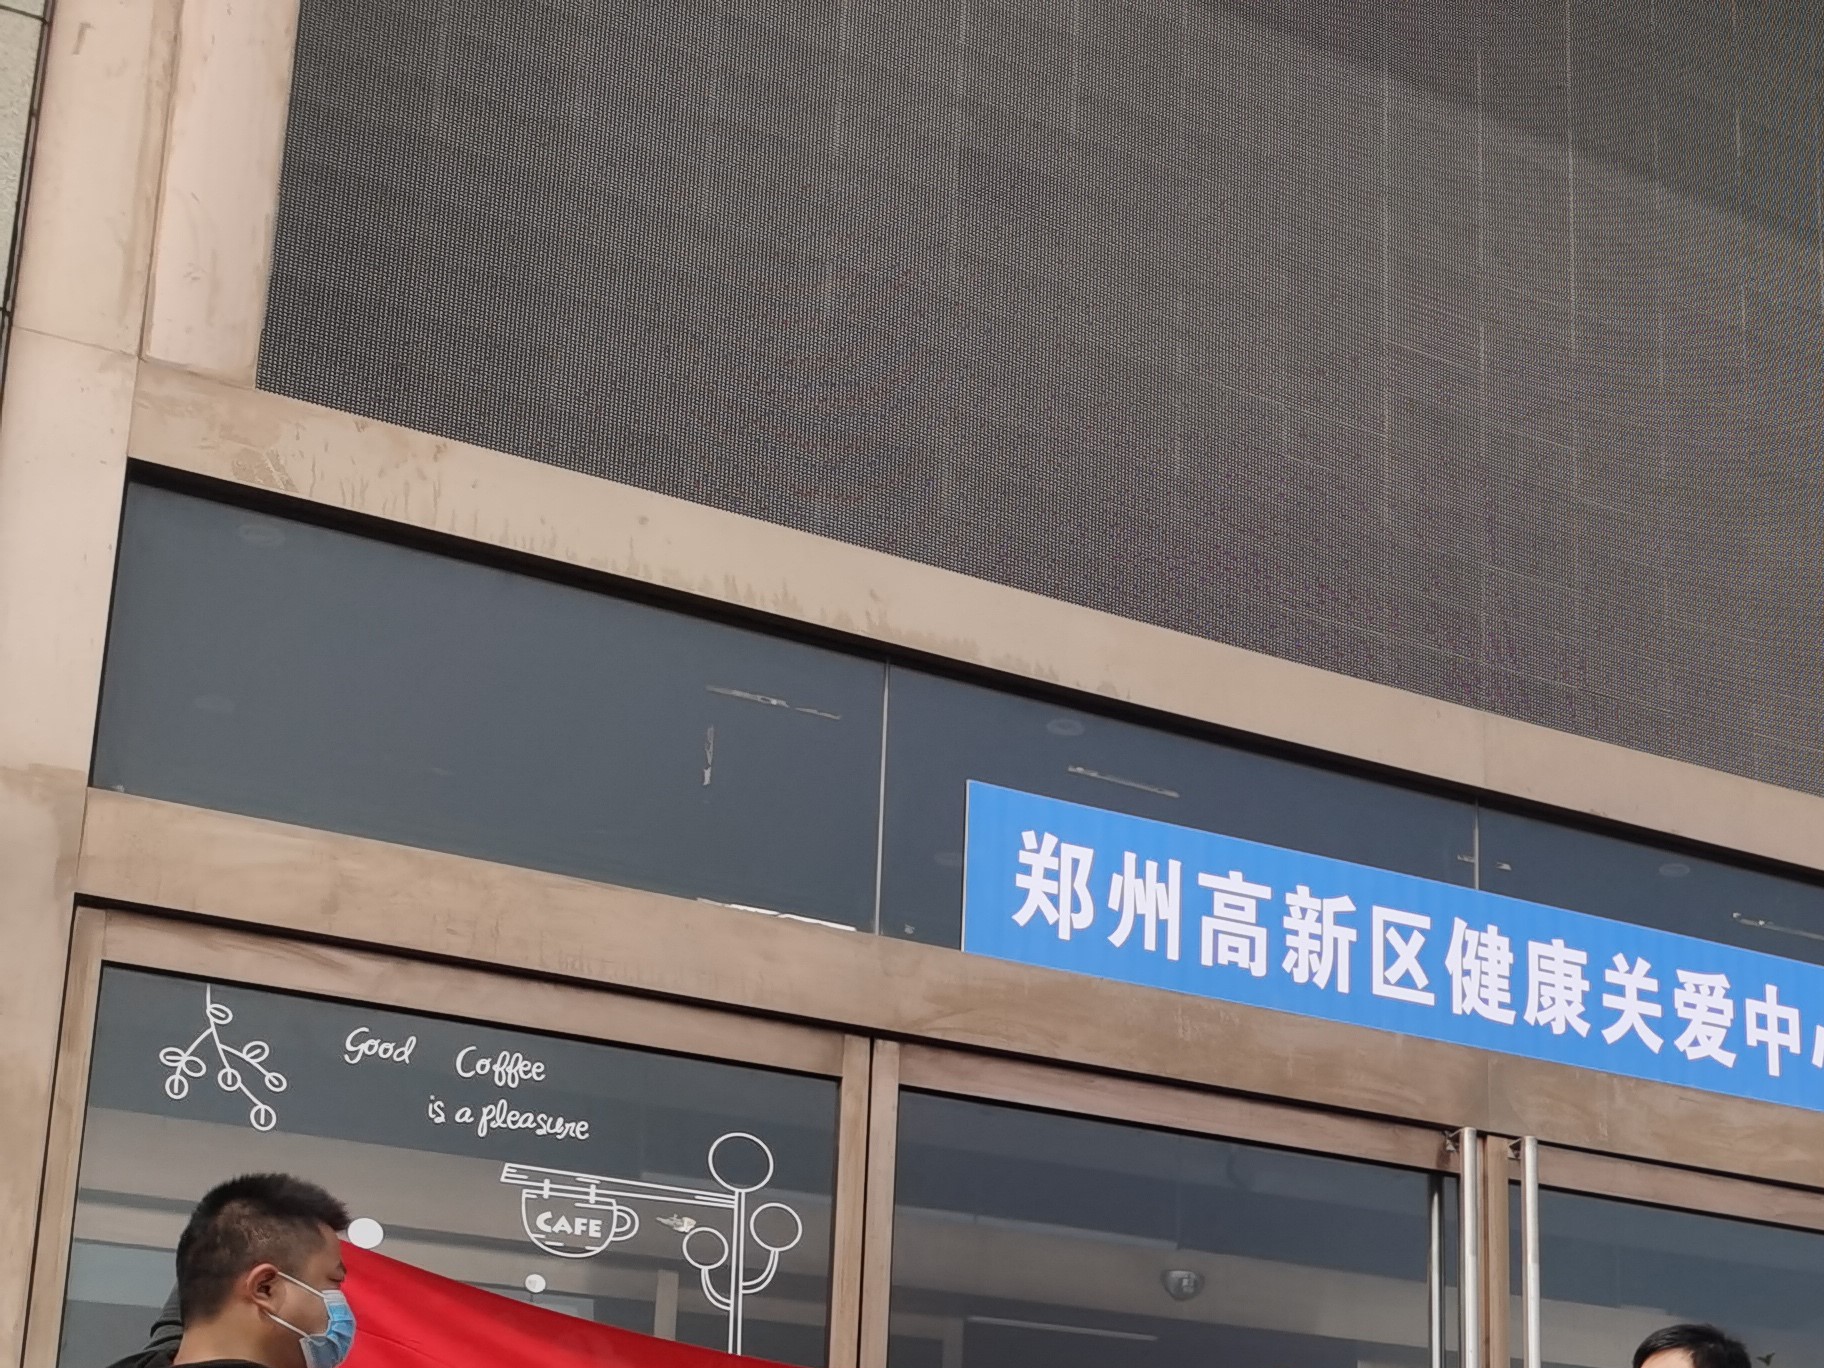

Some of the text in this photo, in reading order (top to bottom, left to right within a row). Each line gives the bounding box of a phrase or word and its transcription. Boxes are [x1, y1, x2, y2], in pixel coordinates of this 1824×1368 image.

[343, 1026, 546, 1089] Good Coffee
[428, 1094, 590, 1140] is a pleasure
[535, 1210, 603, 1238] CAFE
